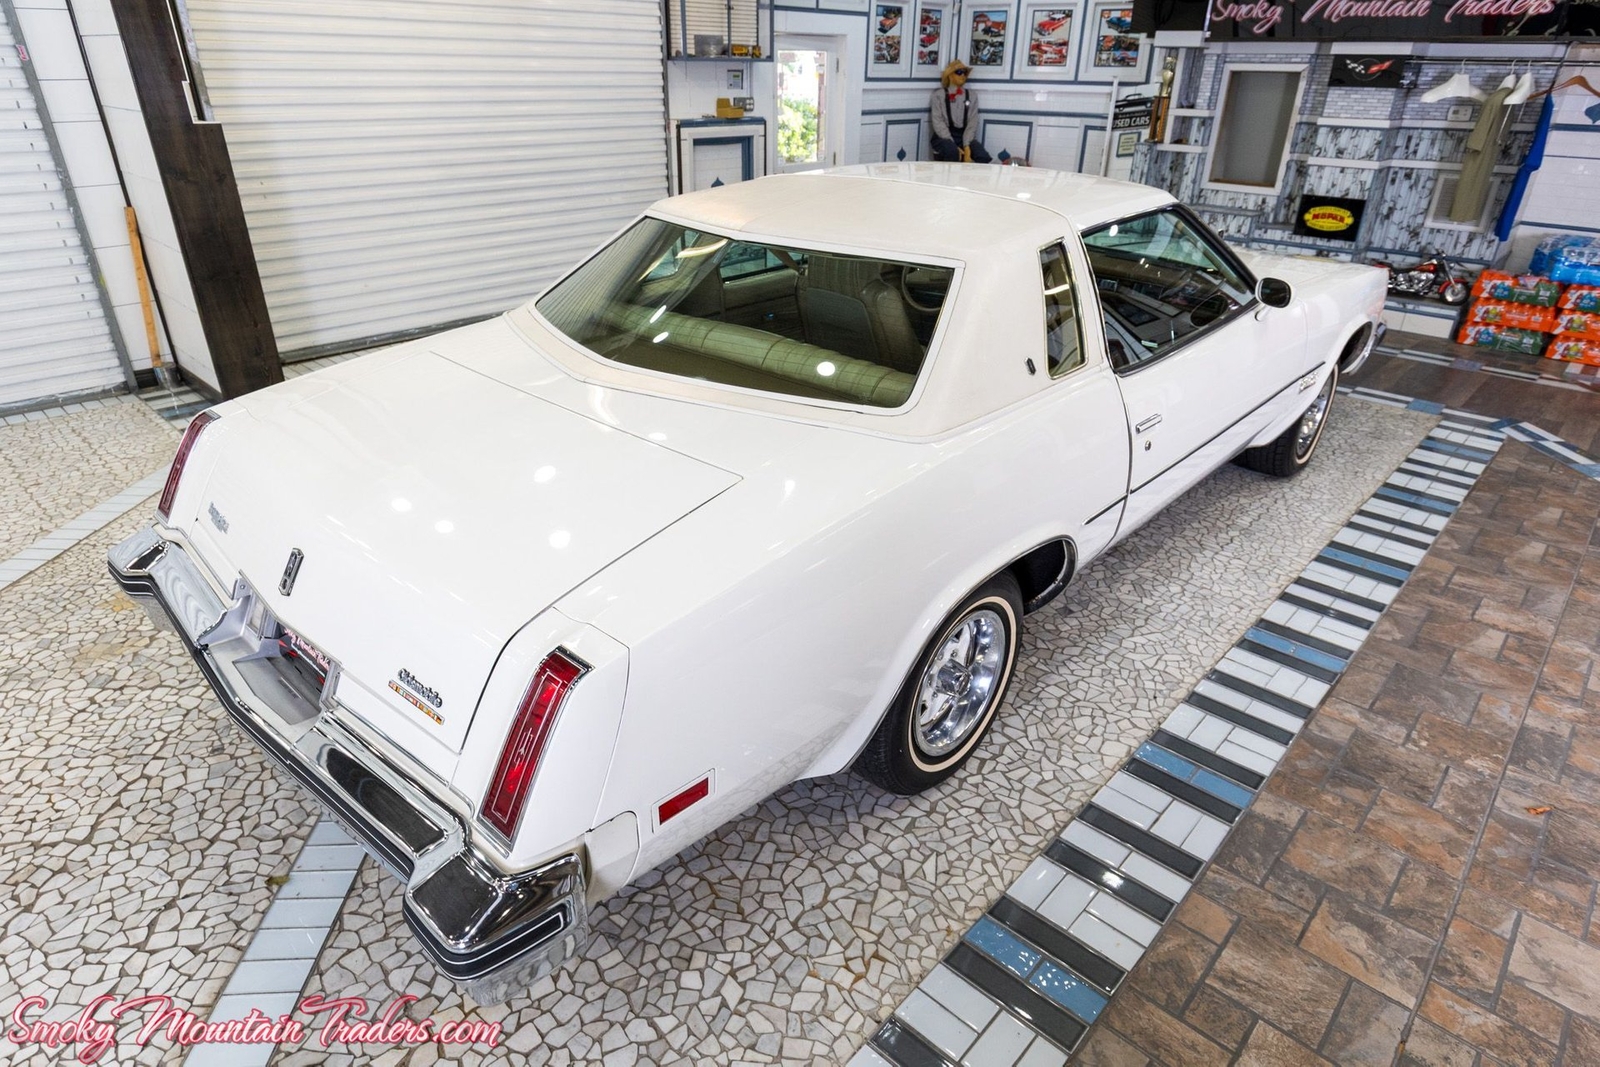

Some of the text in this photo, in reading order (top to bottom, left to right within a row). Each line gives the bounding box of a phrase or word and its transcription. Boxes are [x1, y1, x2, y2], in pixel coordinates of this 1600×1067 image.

[1211, 0, 1284, 34] Smoky
[1300, 0, 1433, 23] Mountain
[1131, 116, 1150, 126] CARS
